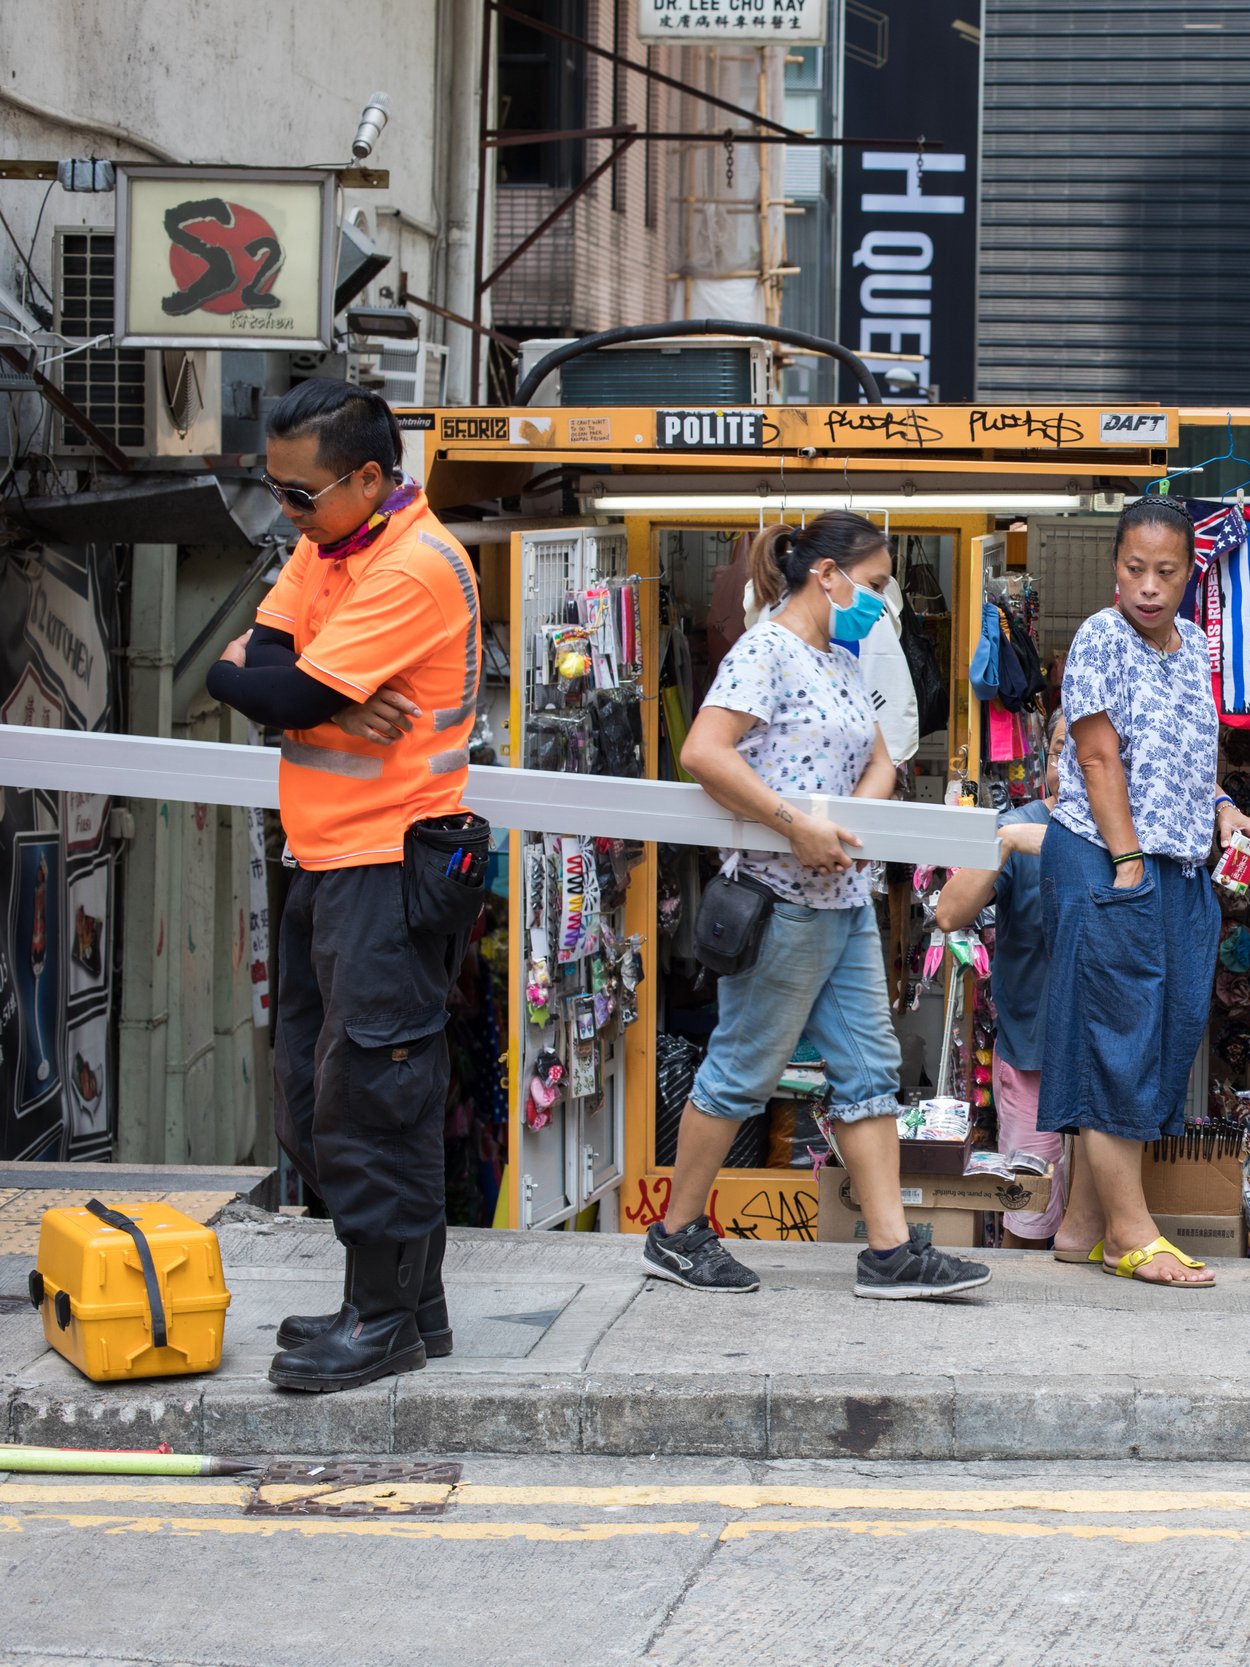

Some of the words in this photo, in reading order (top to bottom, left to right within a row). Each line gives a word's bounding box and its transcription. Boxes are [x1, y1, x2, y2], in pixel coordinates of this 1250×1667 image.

[653, 0, 682, 11] DR.
[689, 0, 720, 11] LEE
[773, 0, 806, 12] KAY
[861, 151, 966, 214] H
[230, 311, 294, 330] Kitchen
[665, 415, 756, 445] POLITE
[1103, 414, 1165, 431] DAFT
